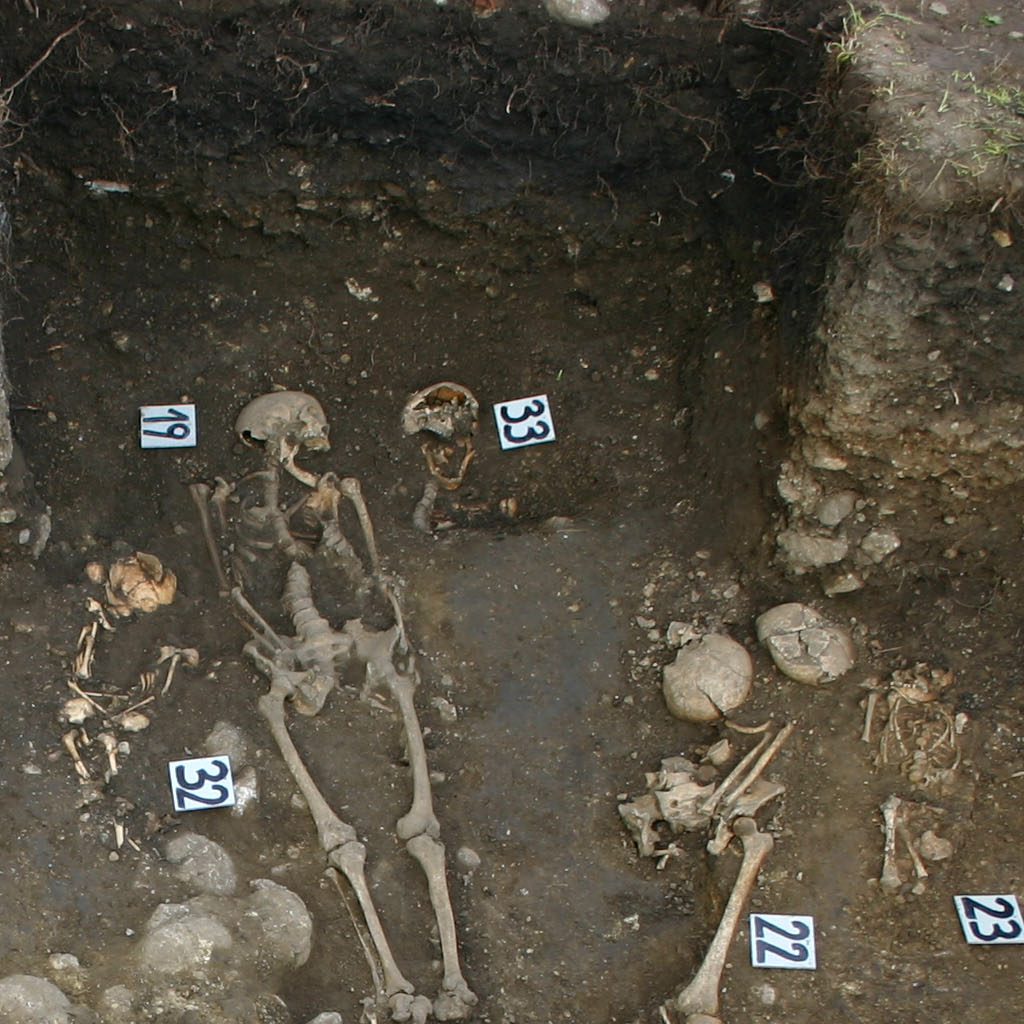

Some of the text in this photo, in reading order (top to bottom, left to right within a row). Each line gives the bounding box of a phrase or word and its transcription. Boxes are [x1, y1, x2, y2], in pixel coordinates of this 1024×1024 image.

[143, 409, 190, 439] 19
[501, 400, 549, 443] 33
[176, 760, 229, 808] 32
[755, 917, 809, 962] 22
[962, 897, 1021, 941] 23
